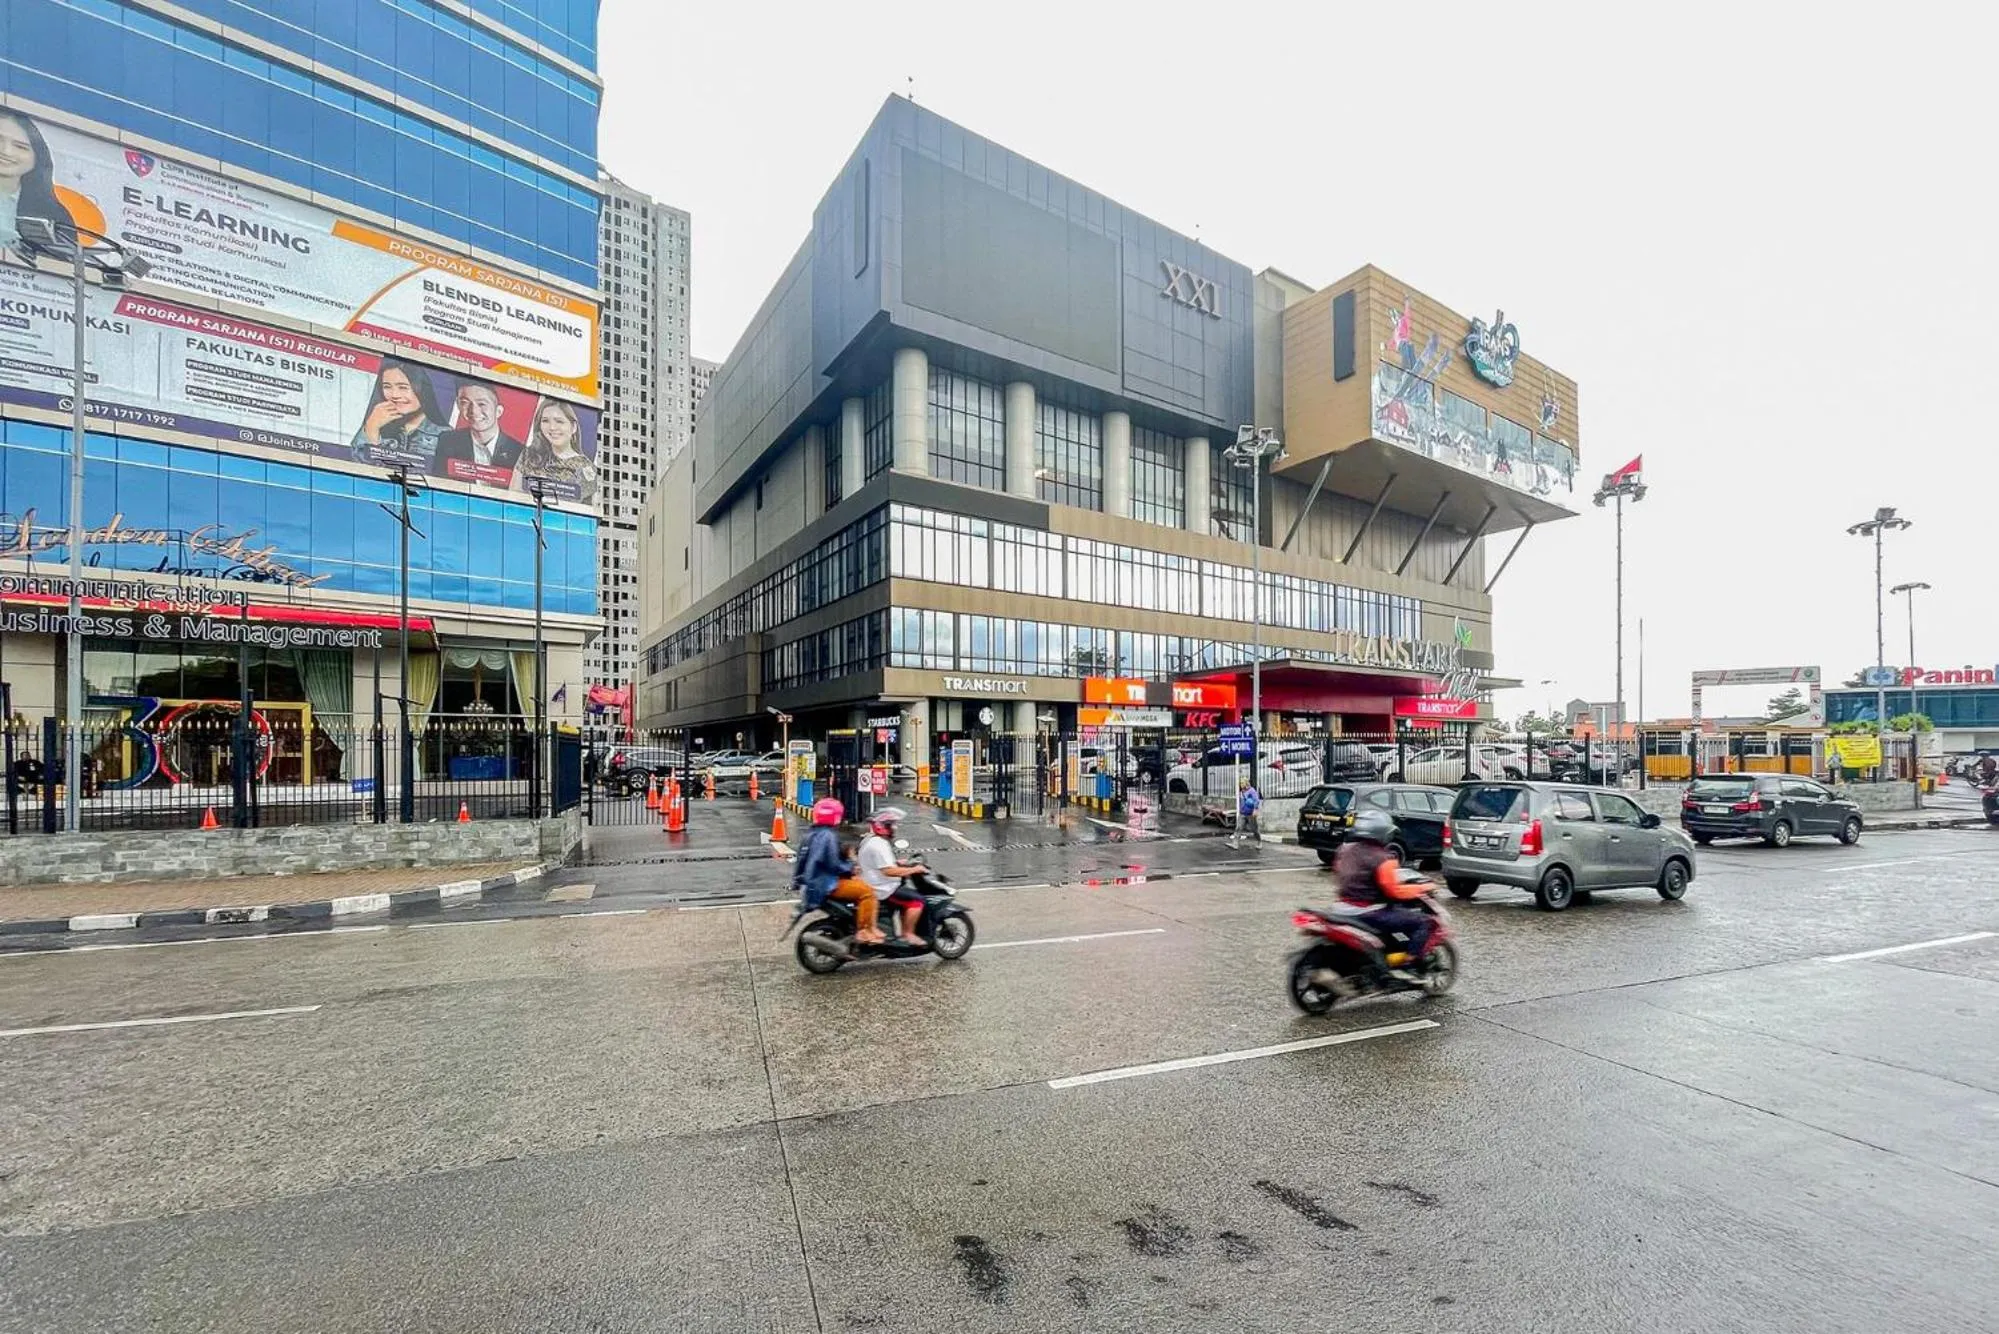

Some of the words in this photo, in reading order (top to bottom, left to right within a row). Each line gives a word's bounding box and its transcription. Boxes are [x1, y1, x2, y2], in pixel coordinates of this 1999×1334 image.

[123, 186, 311, 254] E-LEARNING
[124, 219, 181, 240] Program
[183, 234, 215, 250] Studi
[167, 256, 223, 277] RELATIONS
[233, 273, 270, 290] DIGITAL
[273, 284, 351, 311] COMMUNICATION
[191, 271, 276, 300] COMMUNICATION
[388, 240, 473, 277] PROGRAM
[475, 268, 542, 299] SARJANA
[211, 287, 265, 307] RELATIONS
[1159, 258, 1224, 321] XXI
[0, 298, 131, 335] KOMUNKASI
[423, 279, 503, 313] BLENDED
[506, 305, 583, 339] LEARNING
[126, 302, 199, 327] PROGRAM
[202, 319, 266, 343] SARJANA
[297, 342, 356, 364] REGULAR
[186, 337, 275, 366] FAKULTAS
[280, 359, 335, 381] BISNIS
[82, 403, 109, 415] 817
[112, 408, 144, 420] 1717
[145, 413, 176, 427] 1992
[257, 433, 320, 452] @JoinLSPR
[0, 575, 248, 607] ommunication
[0, 607, 134, 637] usiness
[143, 613, 171, 639] &
[180, 616, 382, 650] Management
[1902, 664, 1999, 687] Panin
[1184, 711, 1222, 728] KFC
